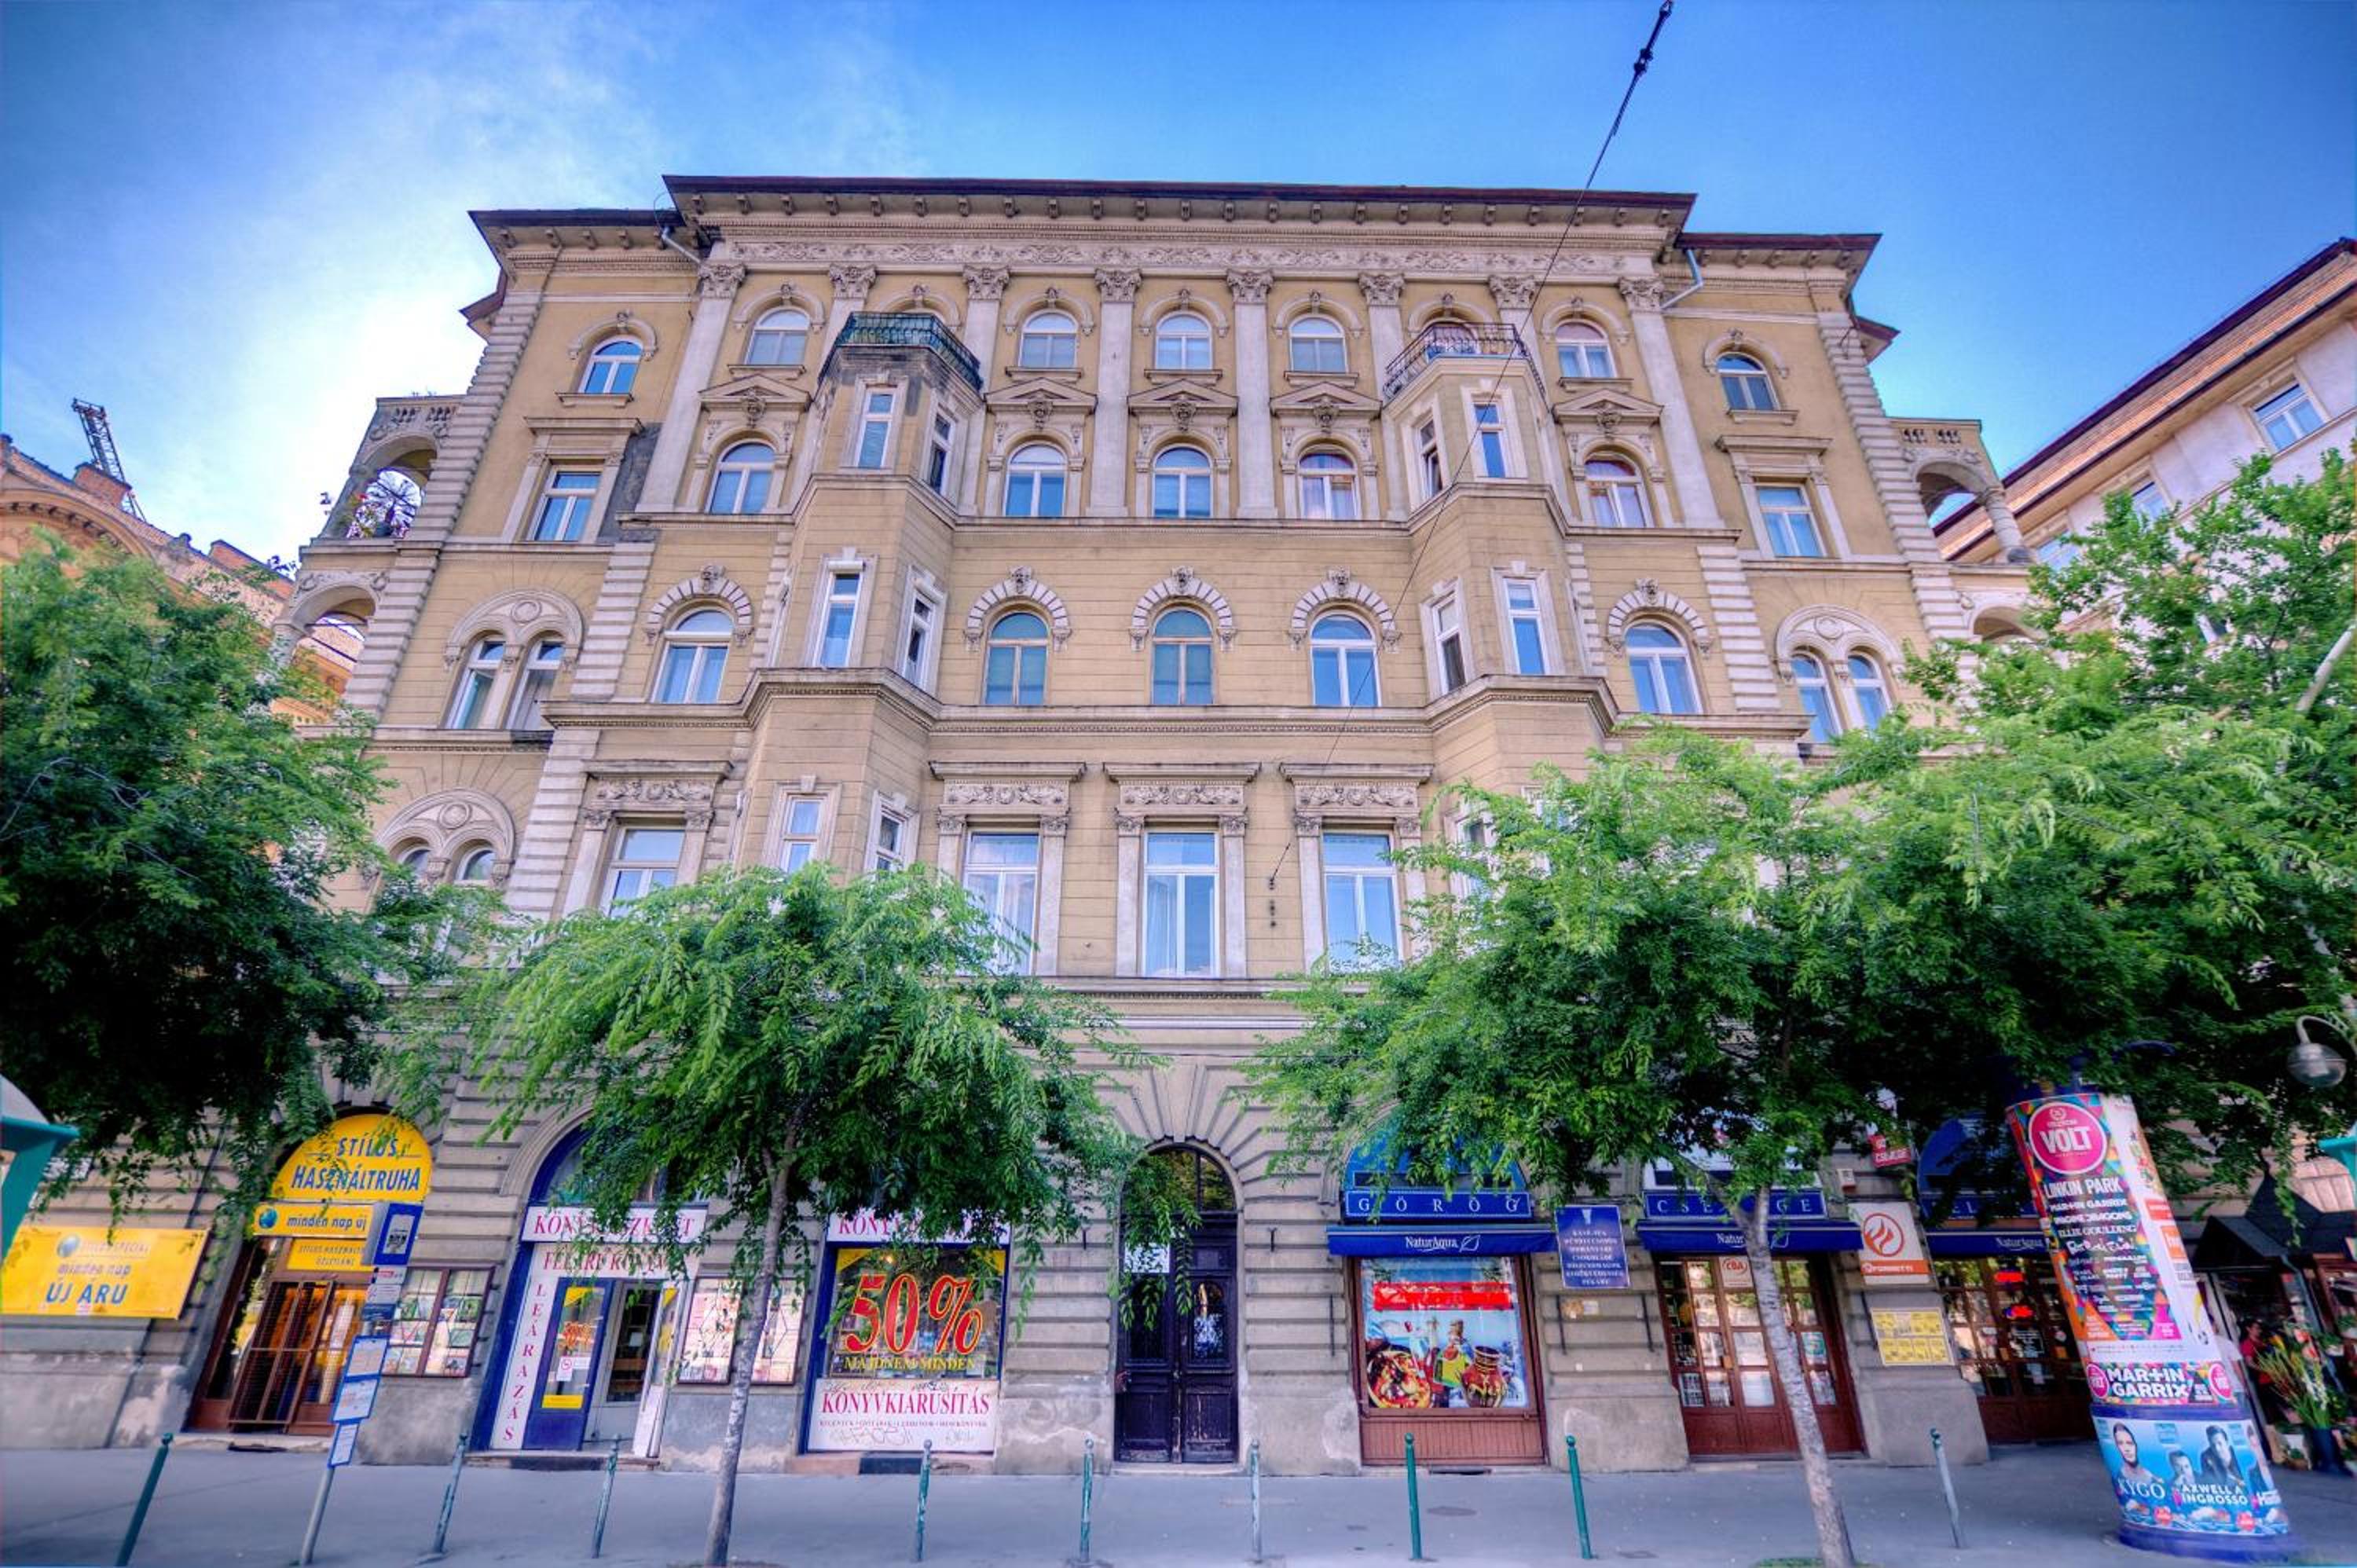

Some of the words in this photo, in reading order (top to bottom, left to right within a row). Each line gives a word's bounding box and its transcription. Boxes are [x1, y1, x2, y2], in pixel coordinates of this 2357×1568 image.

[337, 1132, 399, 1157] STÍLUS
[2040, 1126, 2091, 1153] VOLT
[291, 1163, 421, 1190] HASZNÁLTRUHA
[2044, 1180, 2083, 1199] LINKIN
[2084, 1178, 2124, 1194] PARK
[1358, 1196, 1519, 1212] GÖRÖG
[287, 1213, 328, 1226] minden
[331, 1218, 353, 1230] nap
[1405, 1236, 1459, 1251] NaturAqua
[46, 1277, 73, 1303] ÚJ
[77, 1277, 128, 1305] ÁRU
[845, 1273, 982, 1355] 50%
[845, 1356, 917, 1370] MAJDNEM
[918, 1357, 975, 1371] MINDEN
[2112, 1382, 2190, 1398] GARRIX
[823, 1386, 990, 1416] KÖNYVKIÁRUSÍTÁS
[2182, 1483, 2231, 1493] AXWELL
[2182, 1493, 2249, 1506] INGROSSO
